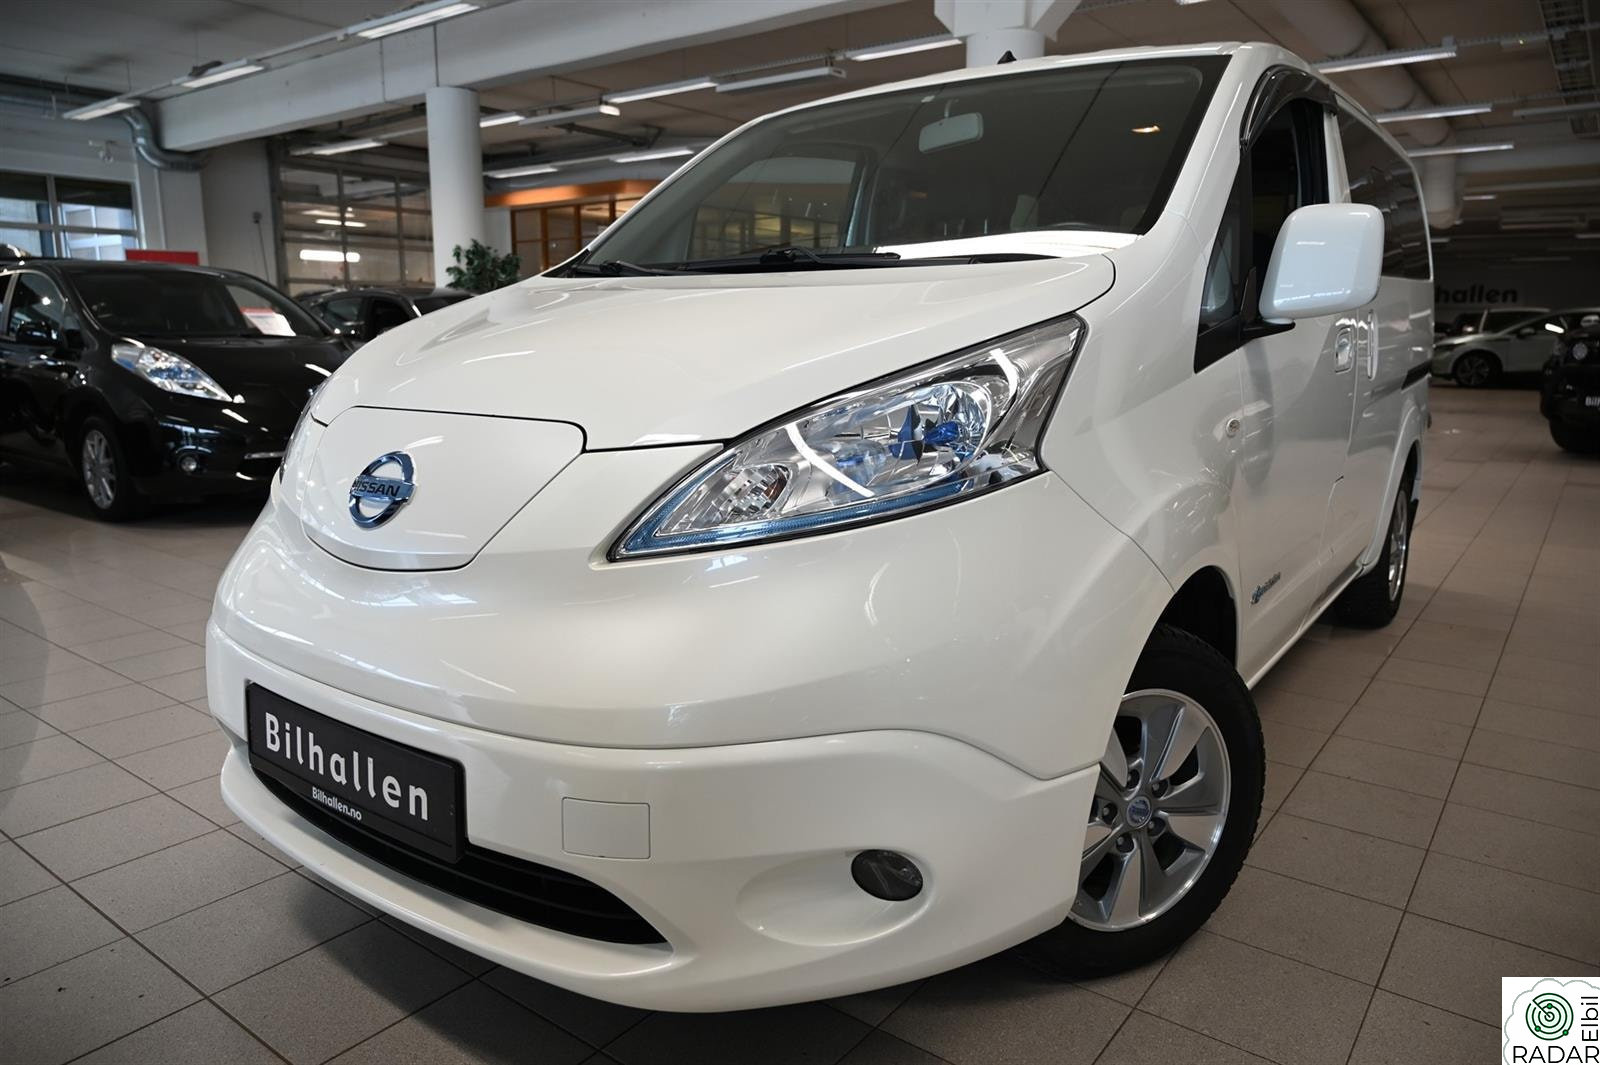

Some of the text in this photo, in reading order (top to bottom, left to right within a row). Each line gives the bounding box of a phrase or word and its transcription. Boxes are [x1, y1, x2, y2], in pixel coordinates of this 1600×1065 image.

[352, 478, 401, 497] NISSAN
[265, 711, 429, 821] Bilhallen
[311, 786, 363, 821] Bilhallen.no
